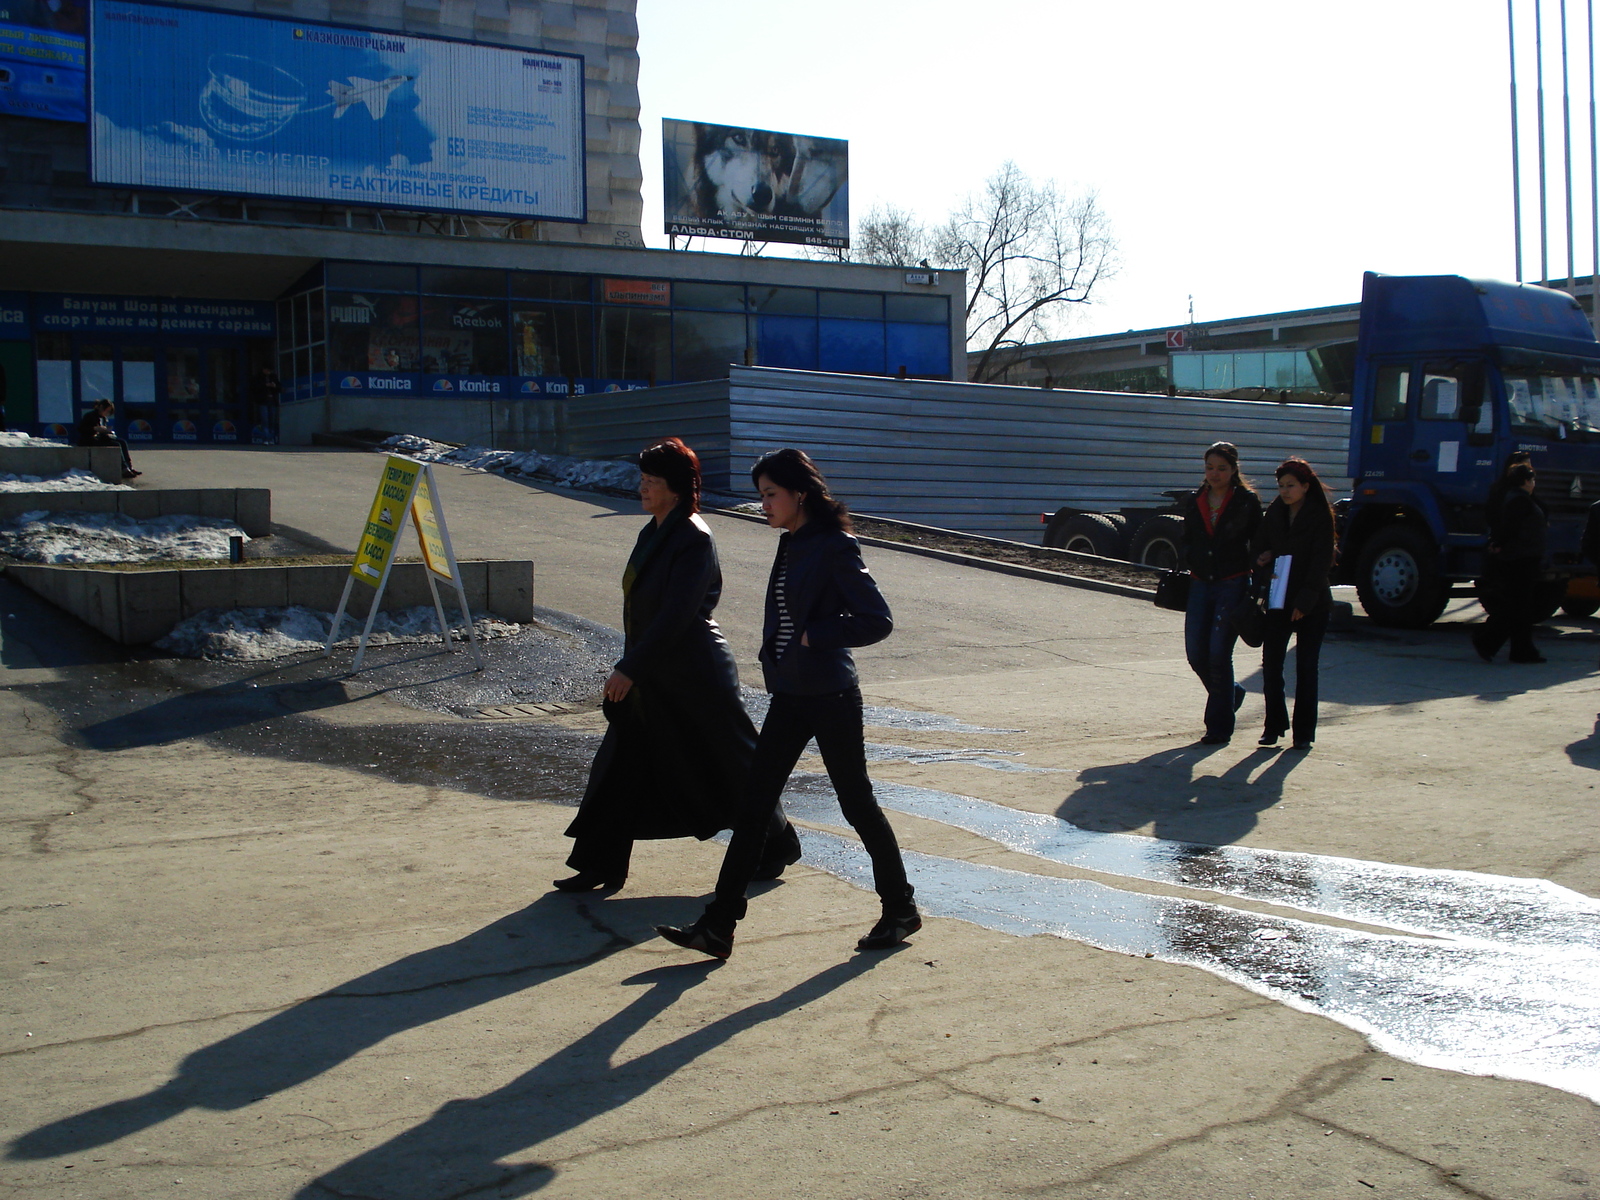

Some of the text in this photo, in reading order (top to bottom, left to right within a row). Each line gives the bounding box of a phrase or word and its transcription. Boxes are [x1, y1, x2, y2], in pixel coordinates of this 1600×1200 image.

[447, 137, 466, 157] БЕЗ
[227, 148, 330, 170] НЕСИЕЛЕР
[430, 170, 446, 181] ДЛЯ
[449, 173, 487, 184] БИЗНЕСА
[329, 174, 453, 198] РЕАКТИВНЫЕ
[458, 186, 539, 205] КРЕДИТЫ
[63, 298, 117, 313] Балуан
[43, 315, 90, 328] спорт
[331, 306, 369, 324] PUMA
[453, 315, 502, 329] Reebok
[368, 377, 412, 391] Konica
[459, 379, 500, 393] Konica
[545, 381, 585, 394] Konca
[364, 542, 385, 562] КАССА
